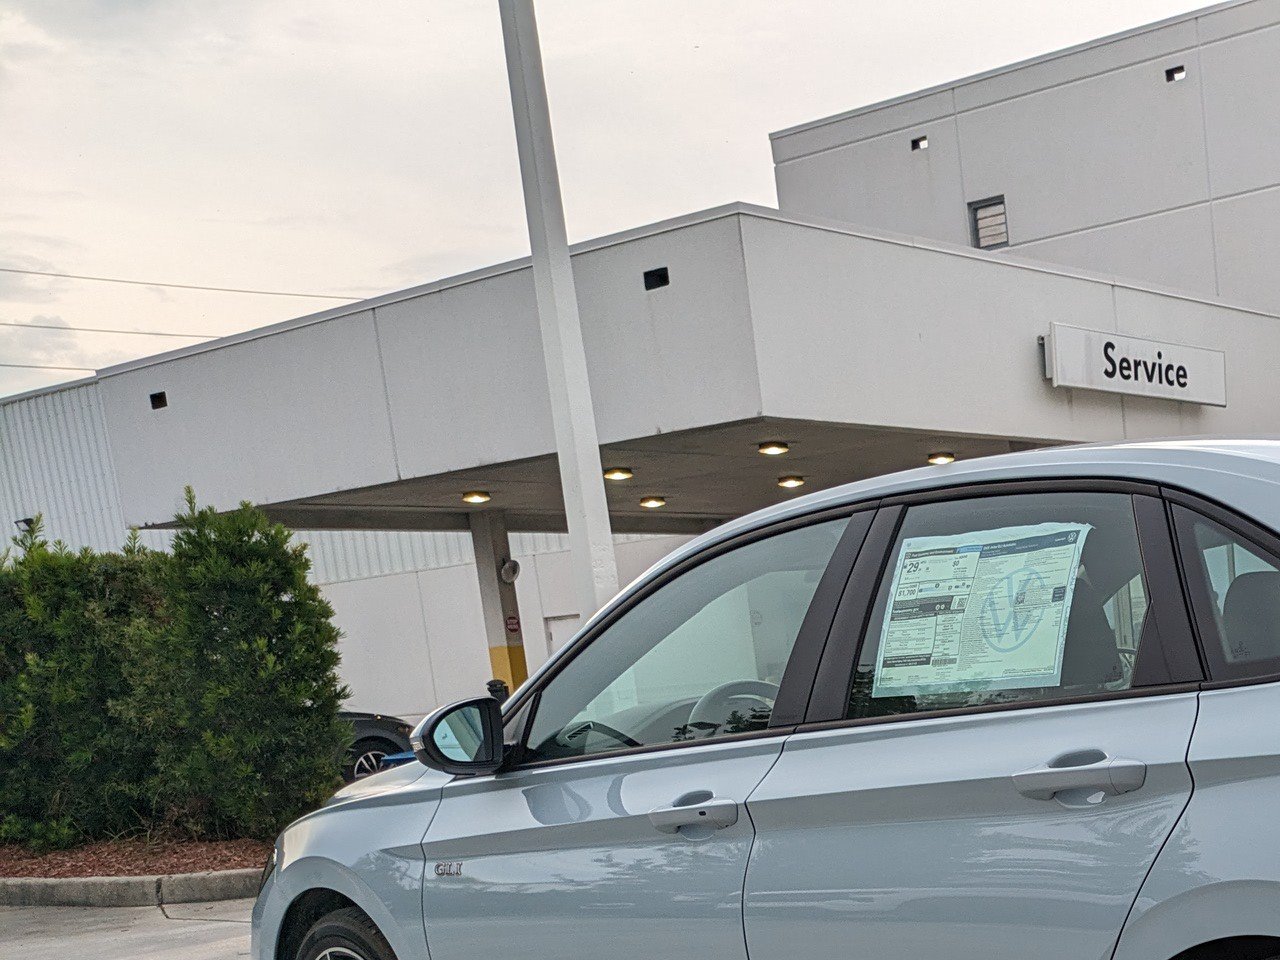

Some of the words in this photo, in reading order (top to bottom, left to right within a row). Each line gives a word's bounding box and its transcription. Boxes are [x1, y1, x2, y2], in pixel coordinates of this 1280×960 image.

[1103, 341, 1188, 388] Service
[906, 561, 920, 574] 29
[434, 861, 464, 877] GLI
